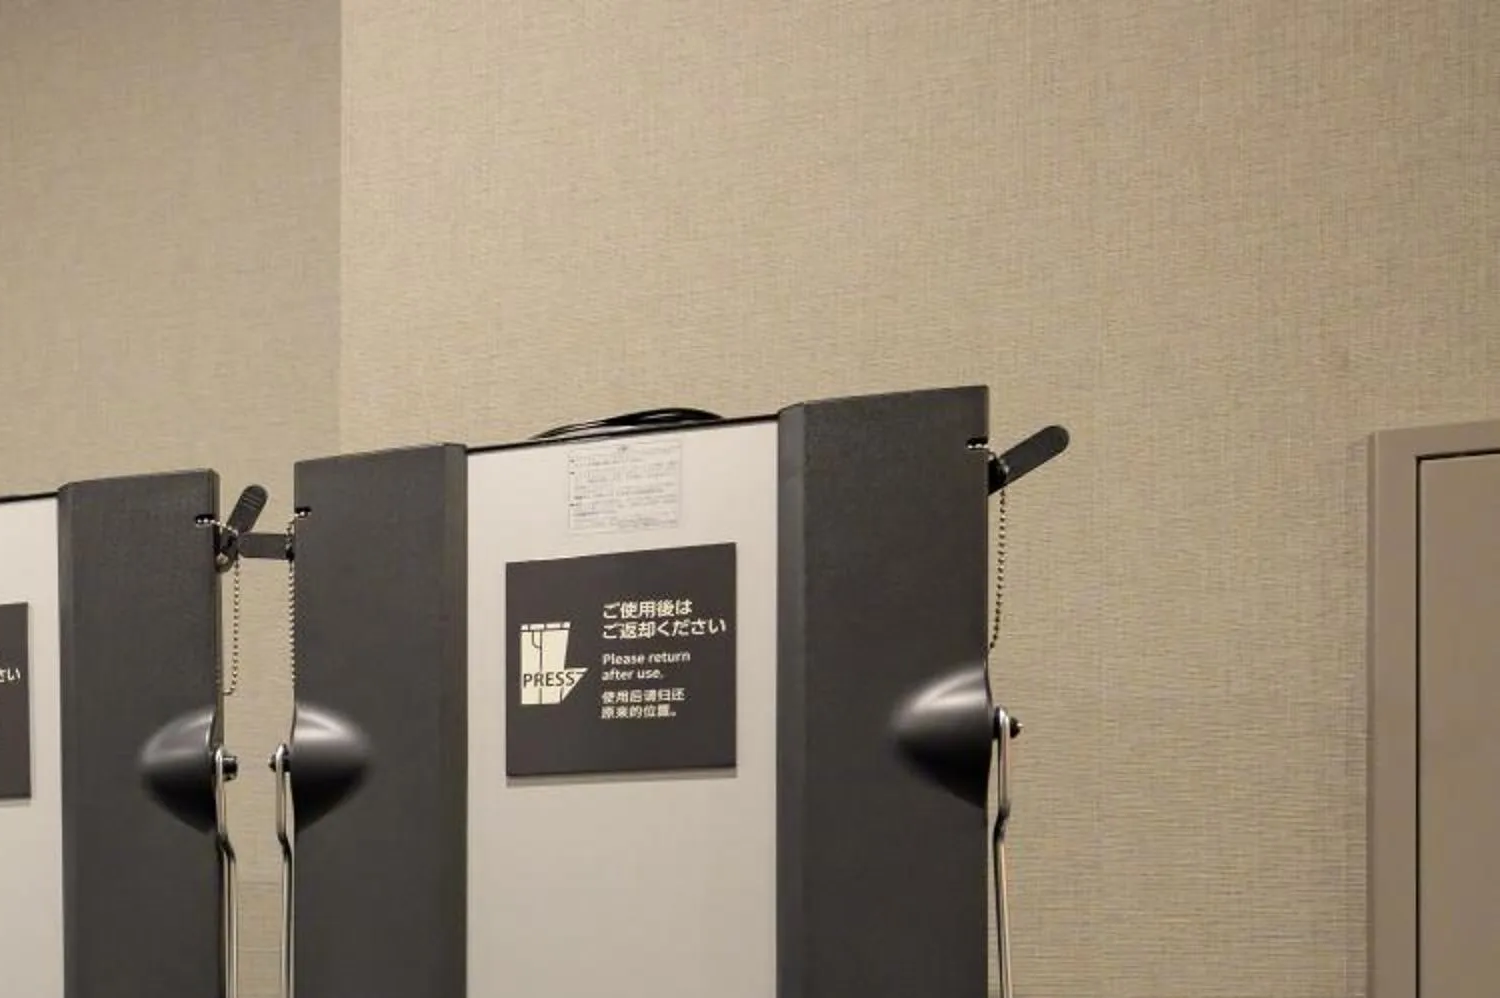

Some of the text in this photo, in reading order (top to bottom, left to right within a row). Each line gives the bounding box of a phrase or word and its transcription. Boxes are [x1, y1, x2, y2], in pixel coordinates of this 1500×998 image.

[603, 599, 693, 619] ご使用後は
[603, 618, 727, 640] ご返却ください
[602, 651, 690, 666] Please return
[523, 671, 575, 688] PRESS
[602, 668, 664, 681] after use.
